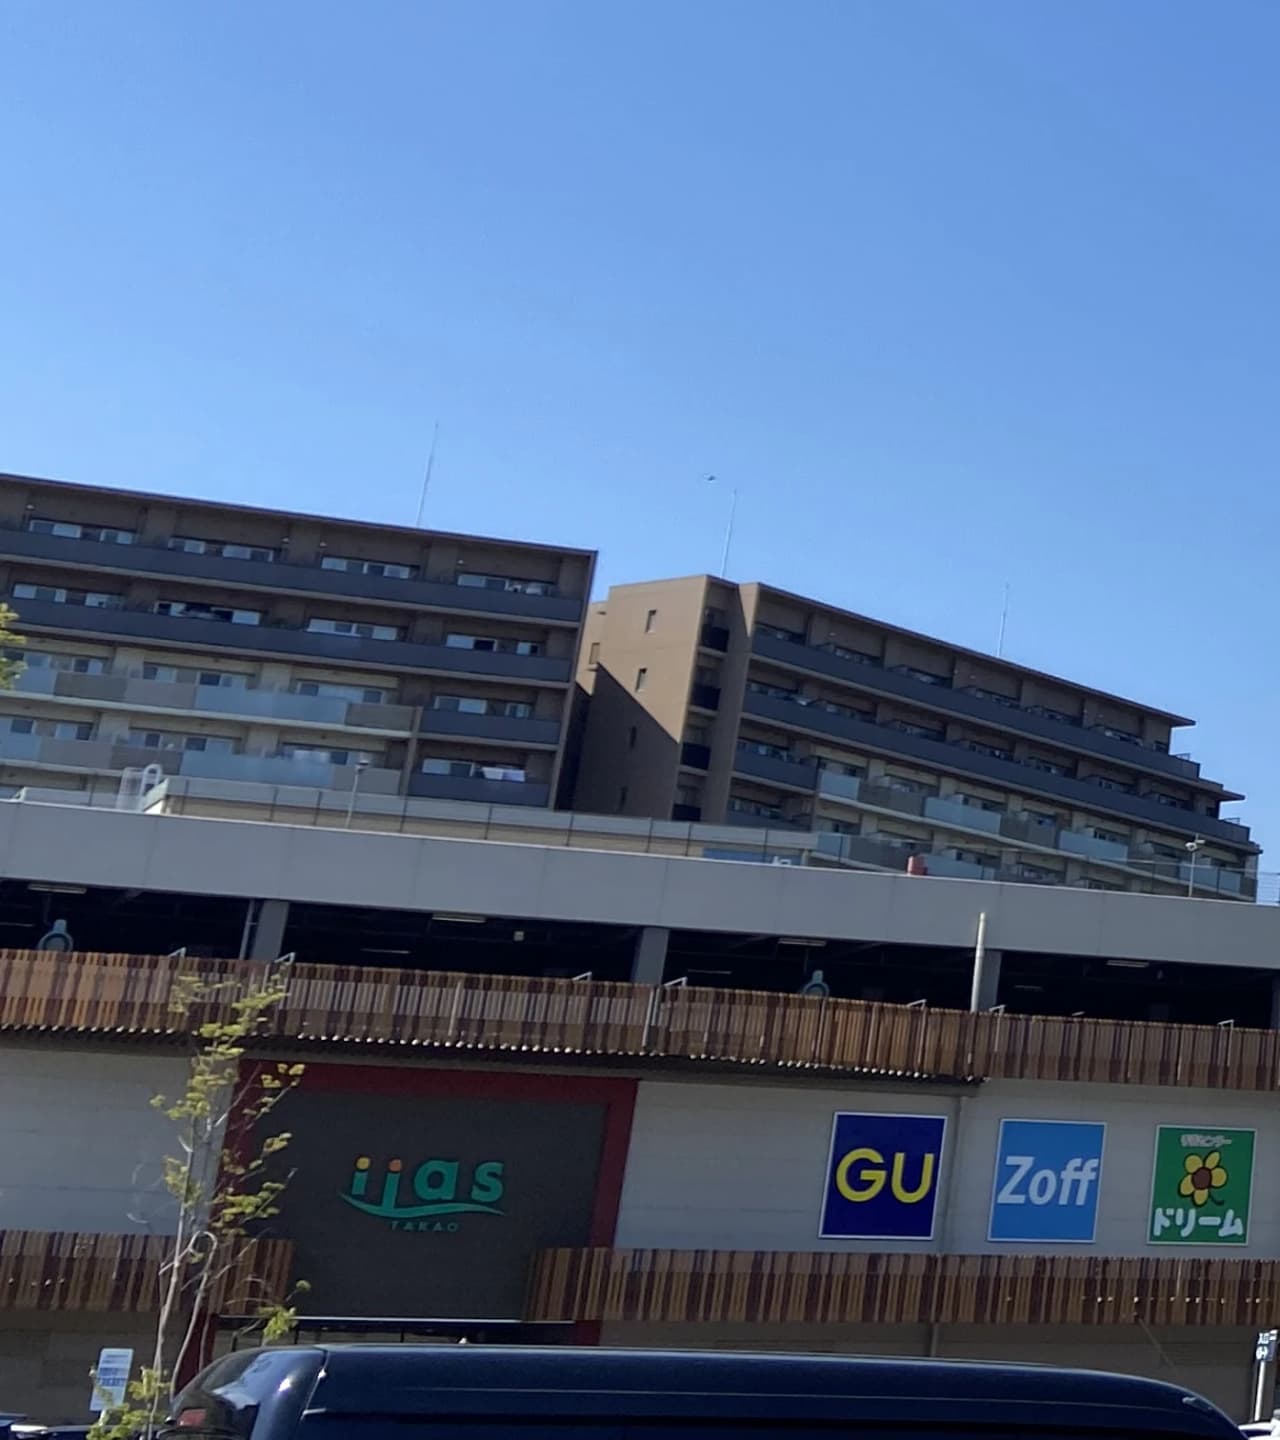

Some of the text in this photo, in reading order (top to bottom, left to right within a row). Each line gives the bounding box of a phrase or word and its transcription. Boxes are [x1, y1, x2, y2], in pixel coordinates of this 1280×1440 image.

[835, 1147, 935, 1203] GU
[997, 1156, 1098, 1205] Zoff
[391, 1221, 458, 1233] TAKAO
[1153, 1207, 1244, 1238] ドリーム
